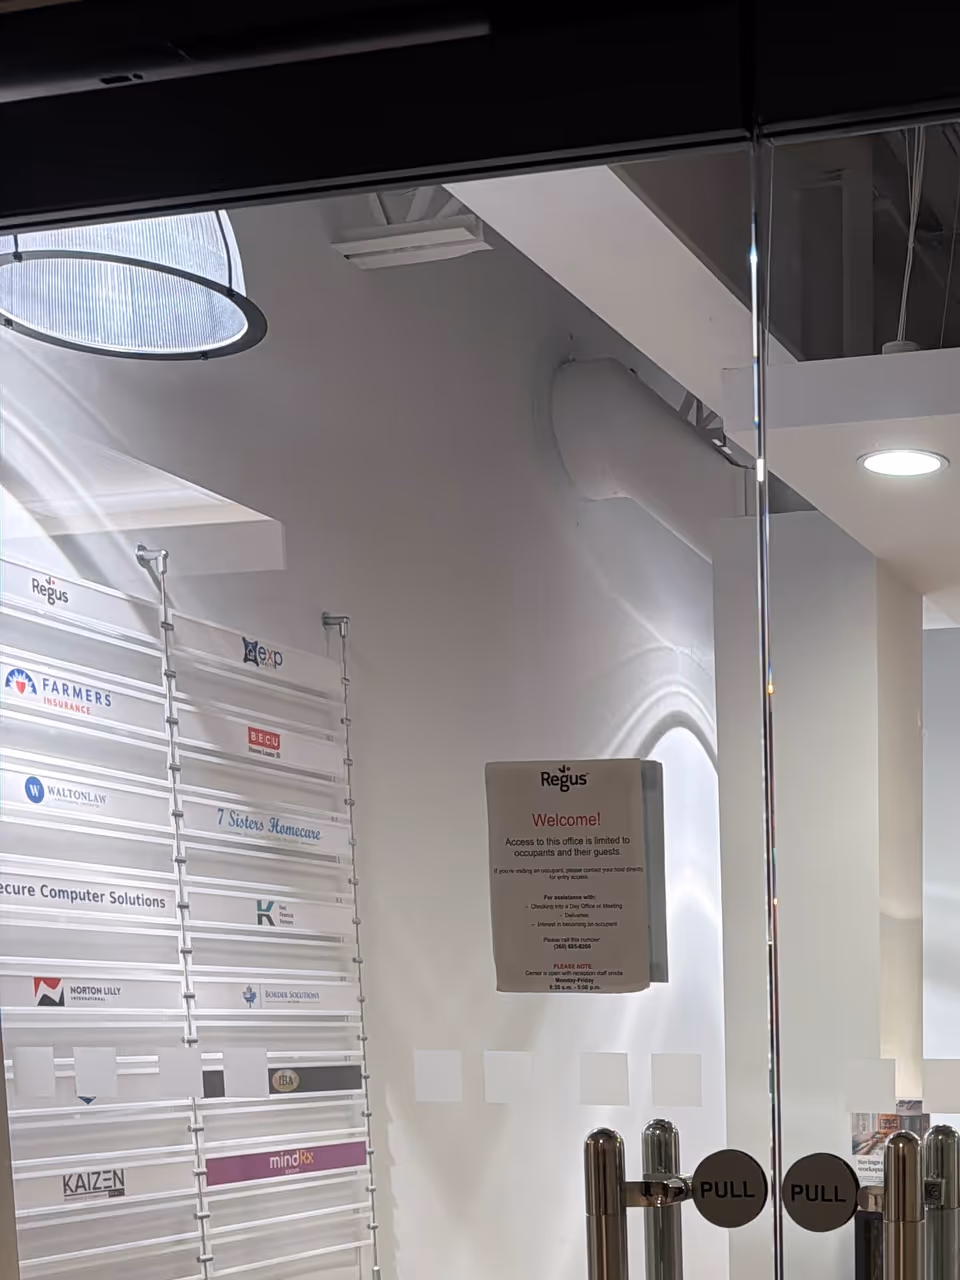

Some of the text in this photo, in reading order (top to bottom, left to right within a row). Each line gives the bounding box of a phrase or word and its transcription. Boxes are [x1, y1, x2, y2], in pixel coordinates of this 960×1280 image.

[32, 577, 69, 605] Regus
[258, 646, 283, 669] exp
[42, 677, 112, 707] FARMERS
[43, 696, 91, 715] INSURANCE
[250, 731, 279, 747] BECU
[540, 765, 588, 792] Regus
[47, 785, 107, 804] WALTONLAW
[217, 808, 225, 825] 7
[228, 809, 264, 832] Sisters
[267, 817, 321, 840] Homecare
[532, 812, 601, 827] Welcome!
[505, 835, 631, 846] Access to this office is limited to
[513, 847, 623, 858] occupants and their guests.
[40, 884, 105, 904] Computer
[109, 891, 166, 909] Solutions
[602, 902, 623, 910] Meeting
[70, 986, 121, 996] NORTON LILLY
[62, 1168, 125, 1194] KAIZEN
[700, 1180, 756, 1199] PULL
[791, 1183, 847, 1203] PULL
